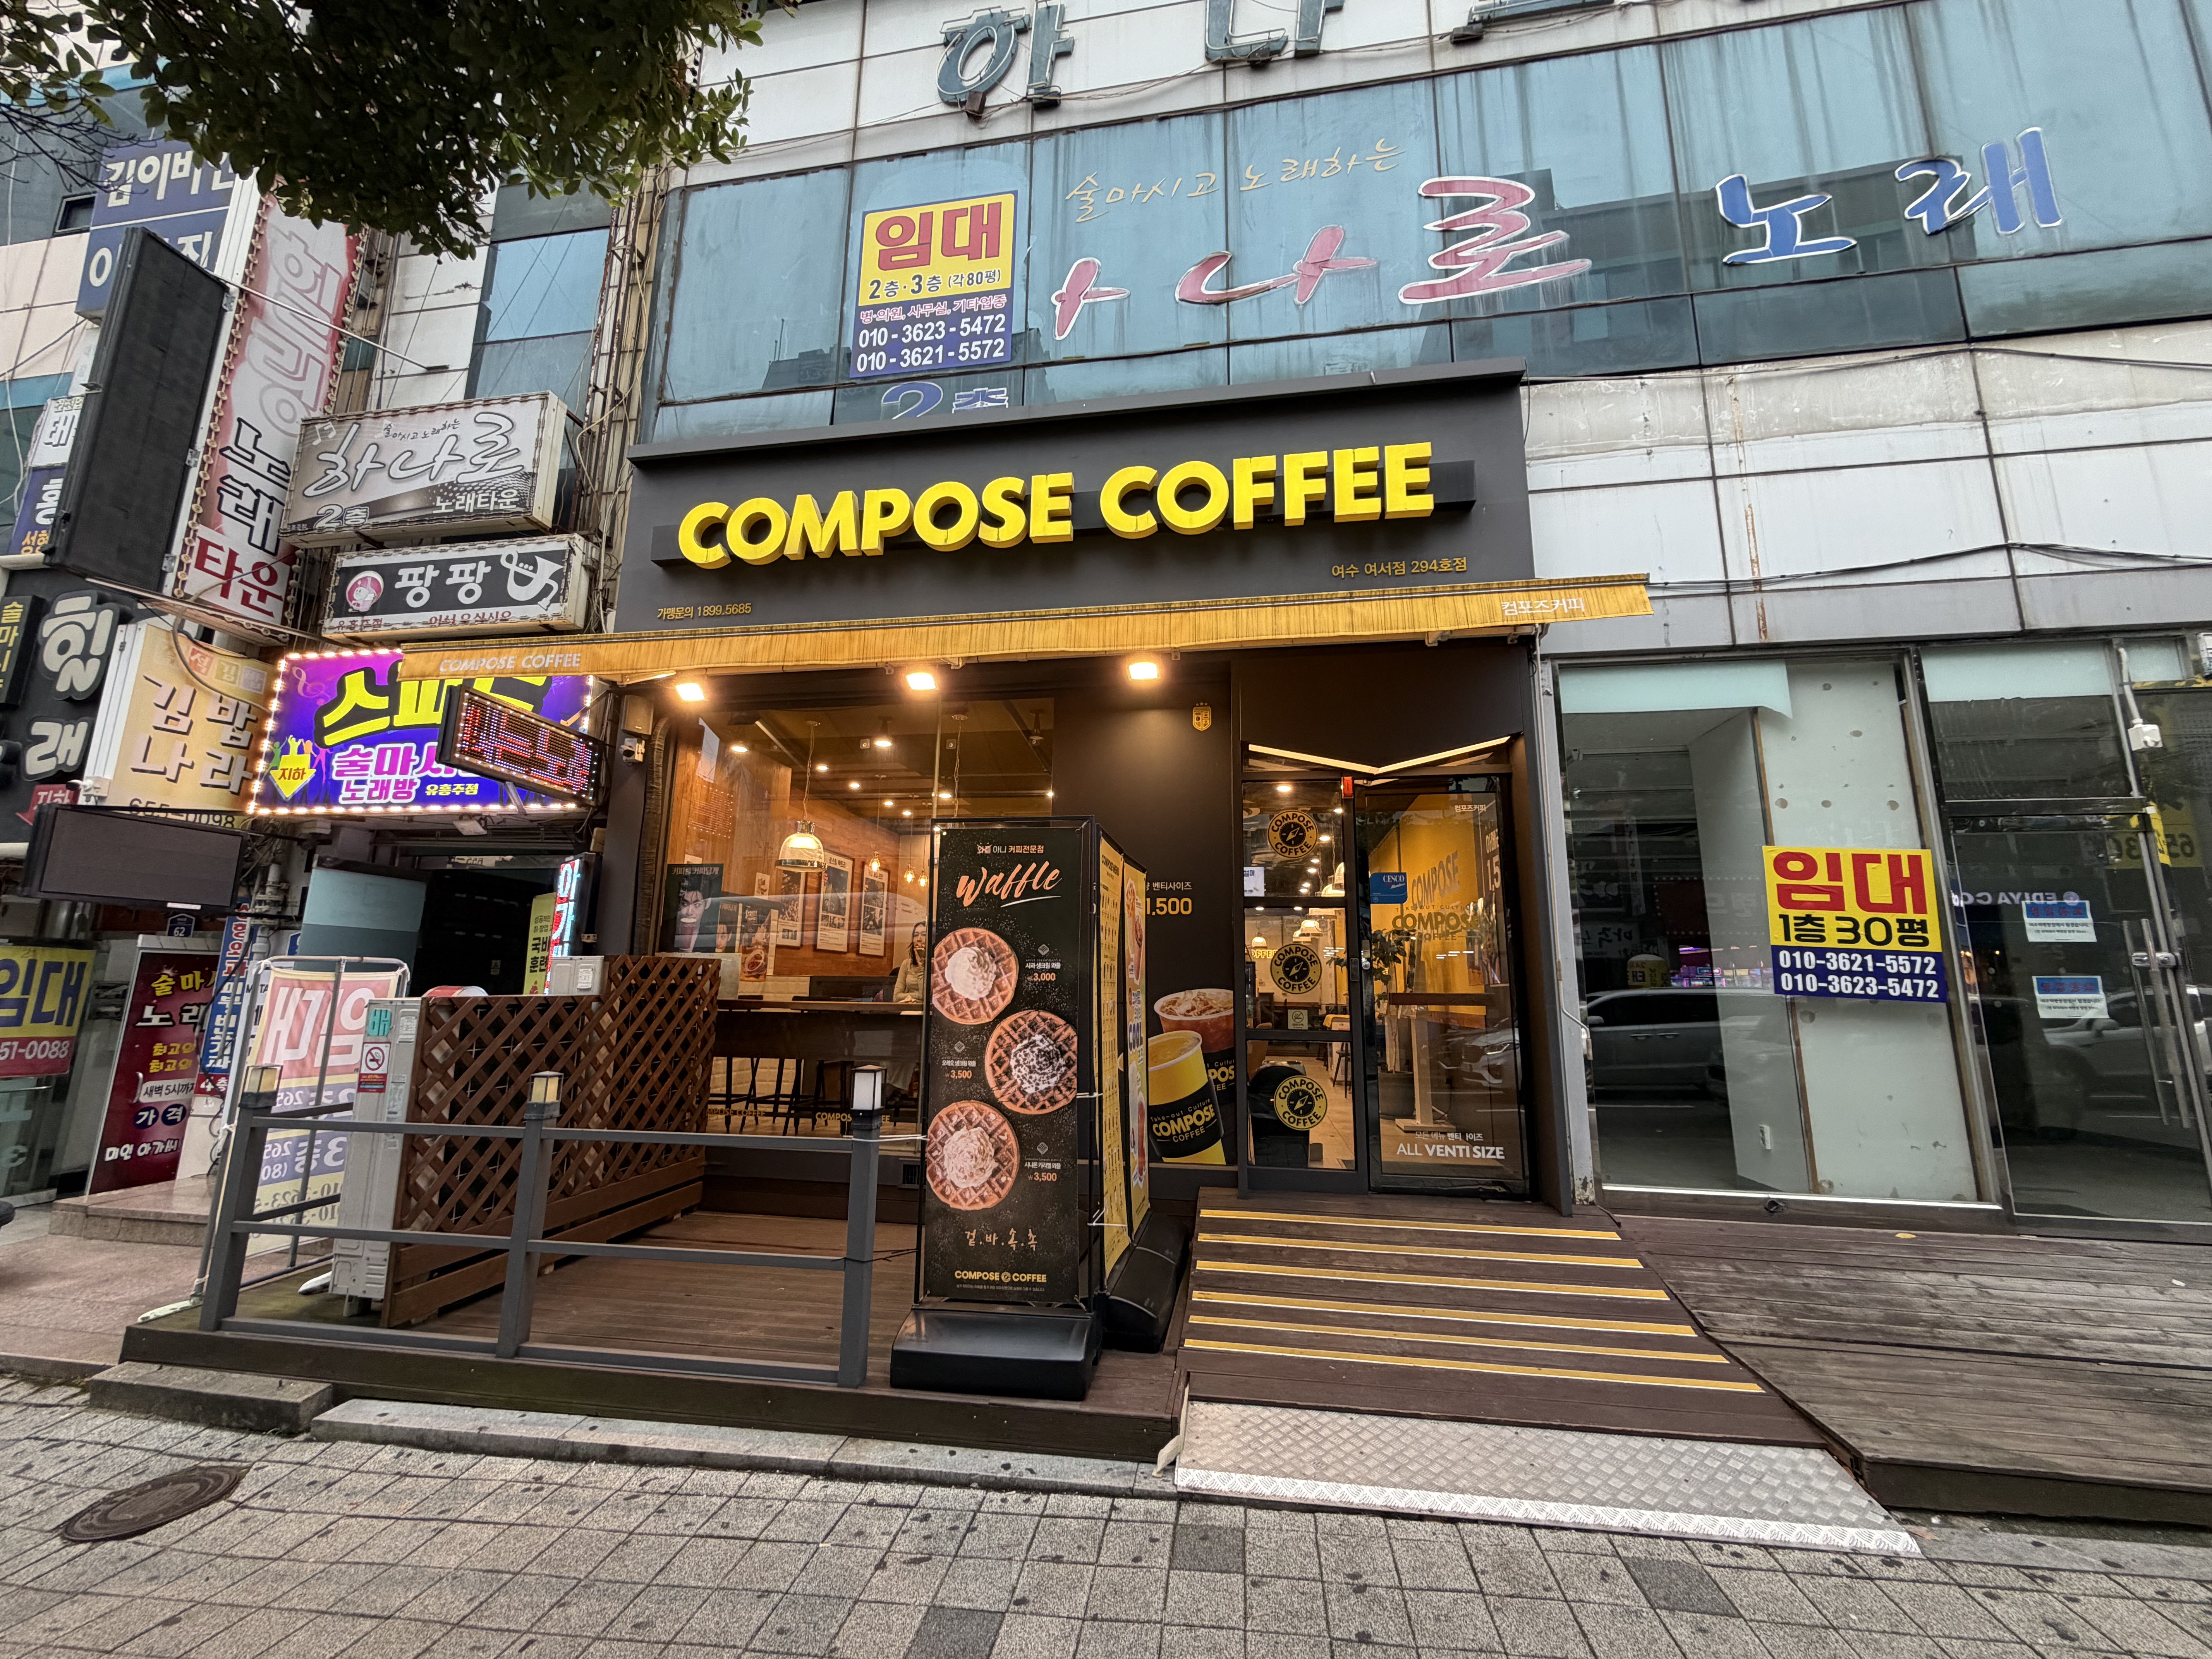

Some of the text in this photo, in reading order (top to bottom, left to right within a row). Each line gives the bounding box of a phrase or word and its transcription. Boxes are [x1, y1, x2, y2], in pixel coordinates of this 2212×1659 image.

[1239, 138, 1405, 191] 노래하는
[1714, 127, 2062, 265] 노래
[875, 201, 1002, 271] 임대
[953, 294, 1007, 313] 기타업종
[859, 313, 1006, 348] 010-3623-5472
[856, 338, 1005, 372] 010-3621-5572
[219, 417, 291, 556] 노래
[432, 489, 520, 514] 노래타운
[678, 441, 1435, 570] COMPOSE COFFEE
[314, 504, 369, 530] 2층
[194, 535, 284, 618] 타운
[1332, 557, 1467, 579] 여수 여서점 294호점
[657, 603, 752, 620] 가맹문의 1899.5685
[1501, 597, 1585, 616] 컴포즈커피
[439, 653, 582, 673] COMPOSE COFFEE
[143, 675, 258, 750] 김밥
[130, 732, 254, 796] 나라
[278, 767, 307, 781] 지하
[342, 778, 419, 804] 노래방
[424, 783, 479, 796] 유흥주점
[1454, 804, 1487, 813] 컴포즈커피
[1271, 813, 1314, 833] COMPOSE
[993, 845, 1007, 854] 아니
[1008, 845, 1044, 854] 커피전문점
[1274, 841, 1312, 857] COFFEE
[956, 860, 1063, 907] Waffle
[1152, 881, 1192, 891] 벤티사이즈
[1382, 874, 1405, 883] CESCO
[1412, 850, 1459, 910] COMPOSE
[1773, 852, 1927, 914] 임대
[173, 927, 185, 936] 62
[1779, 914, 1930, 947] 1층 30평
[1274, 946, 1318, 967] COMPOSE
[1779, 950, 1936, 975] 010-3621-5572
[0, 958, 88, 1027] 임대
[1278, 975, 1316, 993] COFFEE
[1781, 973, 1939, 998] 010-3623-5472
[1278, 1079, 1324, 1101] COMPOSE
[1152, 1103, 1216, 1137] COMPOSE
[1282, 1110, 1321, 1128] COFFEE
[1172, 1127, 1206, 1143] COFFEE
[1447, 1132, 1462, 1141] 벤티
[1396, 1143, 1505, 1159] ALL VENTI SIZE
[955, 1270, 1047, 1283] COMPOSE COFFEE
